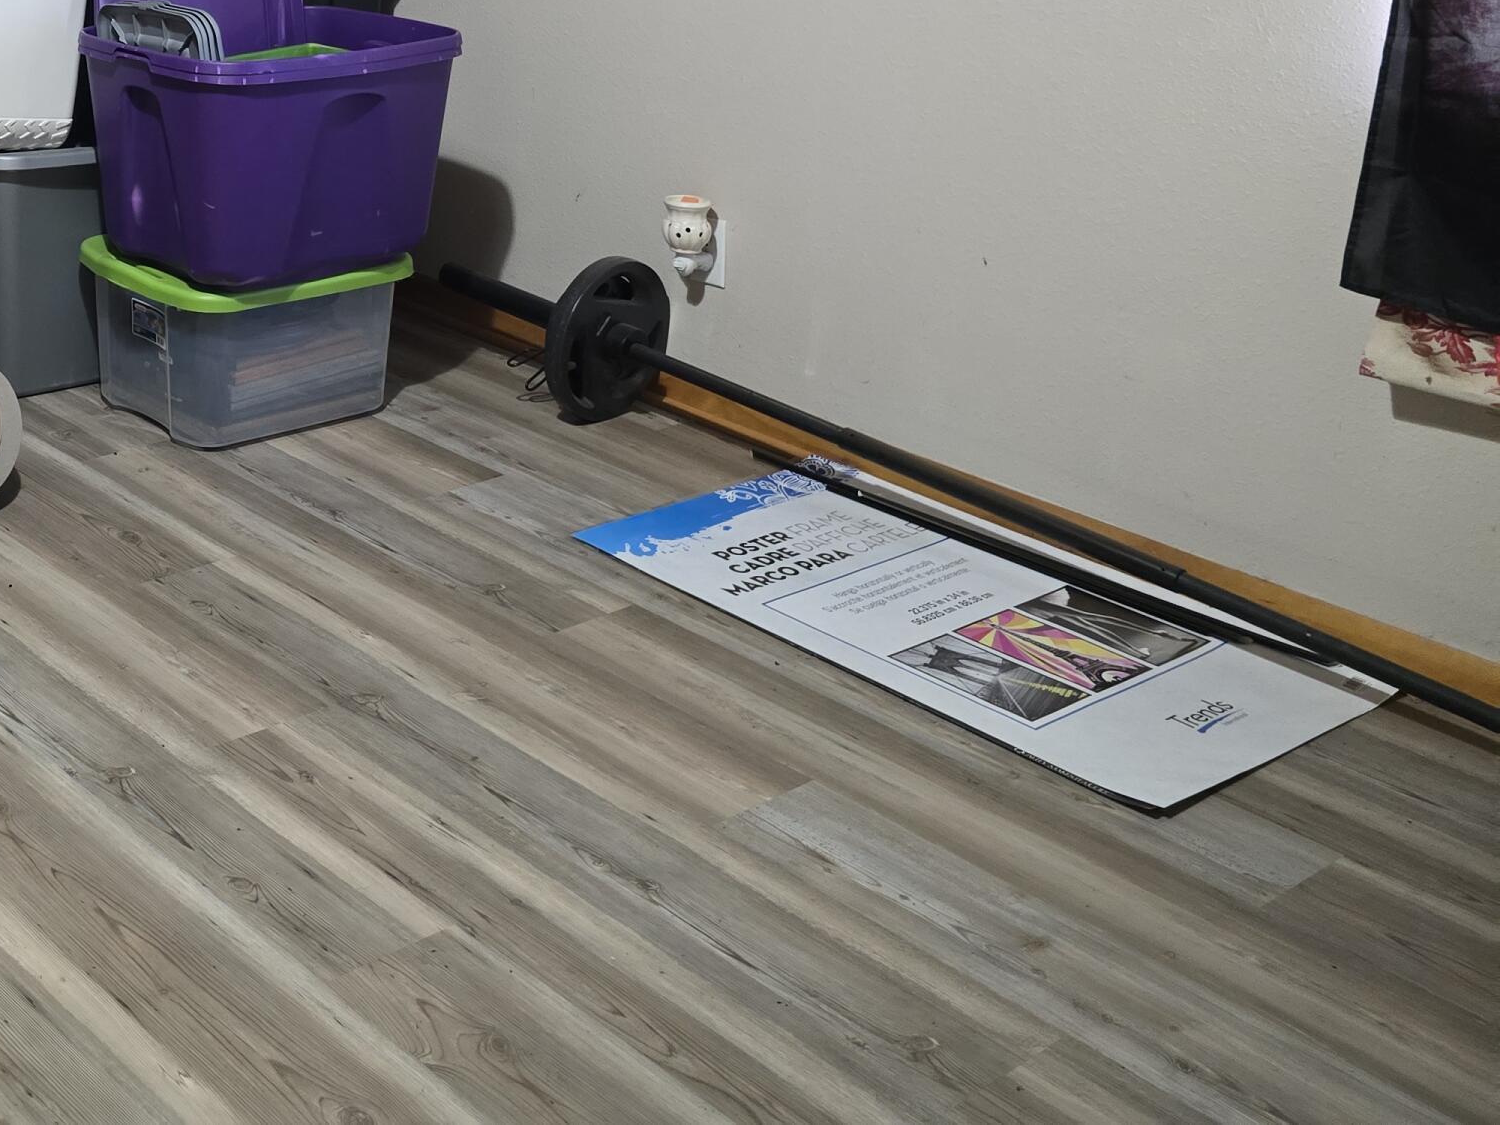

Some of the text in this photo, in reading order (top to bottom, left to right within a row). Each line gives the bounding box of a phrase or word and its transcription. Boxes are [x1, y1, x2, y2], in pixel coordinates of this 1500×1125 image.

[712, 510, 853, 561] POSTER FRAME
[722, 522, 926, 596] MARCO PARA CARTELE
[729, 518, 886, 574] CADRE D'AFFICHE
[1165, 699, 1234, 729] Trends
